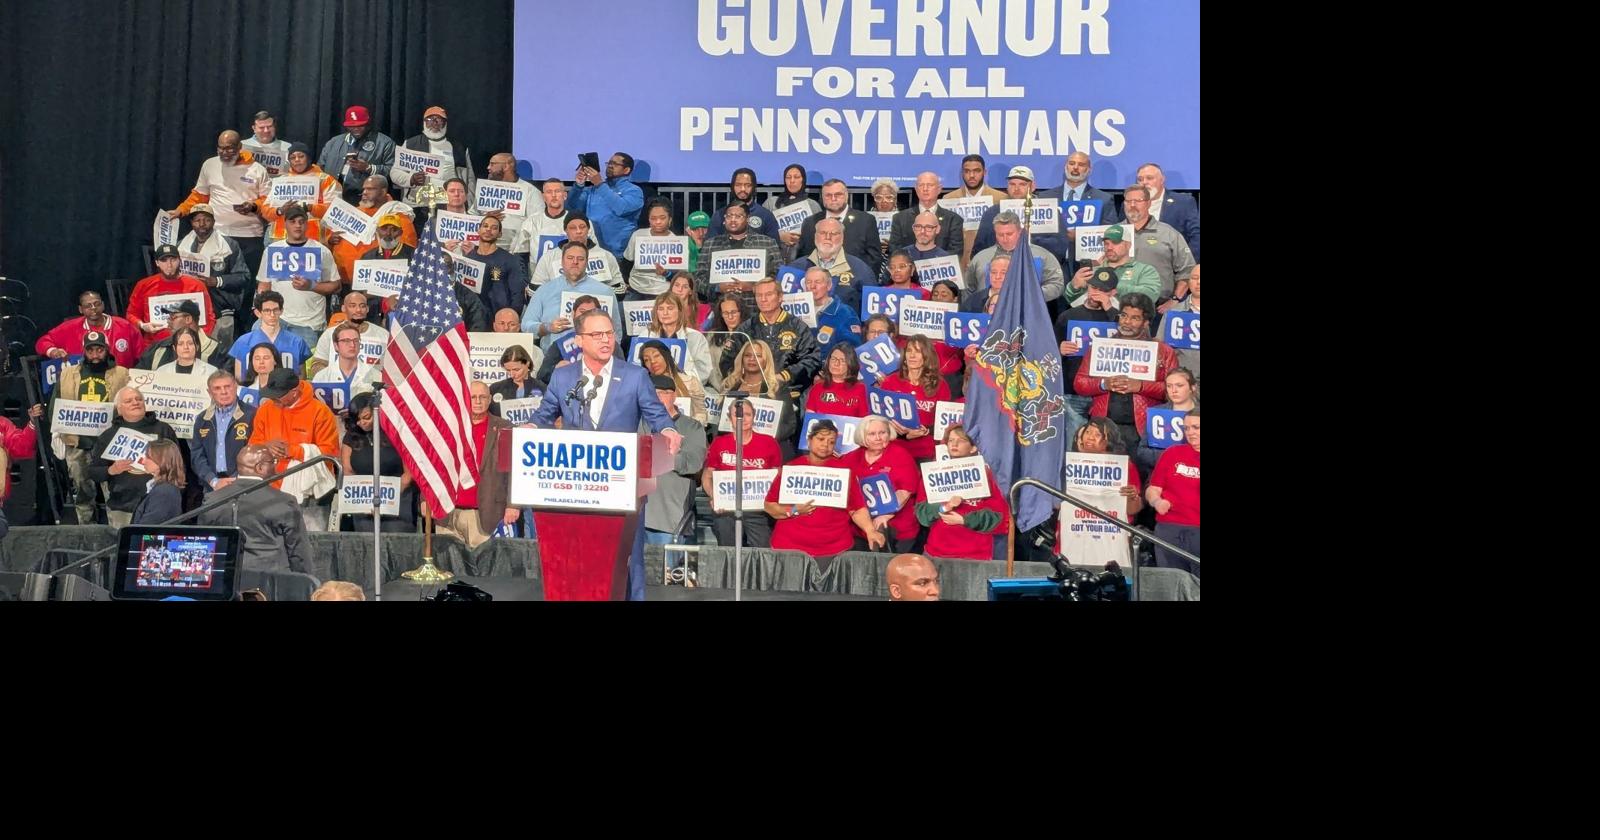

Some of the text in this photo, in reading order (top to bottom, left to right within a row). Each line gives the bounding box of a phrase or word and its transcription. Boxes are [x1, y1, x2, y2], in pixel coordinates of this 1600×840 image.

[697, 0, 1110, 57] GOVERNOR
[776, 67, 1024, 98] FOR ALL
[680, 106, 1126, 156] PENNSYLVANIANS
[399, 152, 440, 167] SHAPIRO
[399, 160, 424, 173] DAVIS
[273, 184, 315, 196] SHAPIRO
[479, 186, 523, 201] SHAPIRO
[478, 197, 504, 209] DAVIS
[330, 206, 367, 234] SHAPIRO
[779, 210, 809, 229] APIRO
[1062, 204, 1096, 224] SD
[439, 229, 465, 241] DAVIS
[639, 243, 684, 255] SHAPIRO
[179, 260, 206, 273] APIRO
[639, 254, 667, 266] DAVIS
[715, 258, 761, 271] SHAPIRO
[904, 309, 944, 324] SHAPIR
[949, 317, 985, 341] GS
[1170, 317, 1200, 343] GS
[859, 342, 895, 373] SD
[1097, 346, 1152, 363] SHAPIRO
[1096, 359, 1130, 374] DAVIS
[152, 384, 202, 395] Pennsylvania
[144, 396, 204, 410] HYSICIANS
[869, 392, 913, 420] GSD
[58, 409, 108, 424] SHAPIRO
[64, 421, 99, 429] GOVERNOR
[1152, 415, 1185, 442] GS
[521, 440, 626, 471] SHAPIRO
[538, 470, 609, 482] GOVERNOR
[928, 467, 981, 488] SHAPIRO
[1066, 463, 1122, 481] SHAPIRO
[553, 482, 573, 490] GSD
[575, 483, 583, 491] TO
[583, 484, 609, 492] 32210
[786, 475, 842, 493] SHAPIRO
[937, 482, 974, 493] GOVERNOR
[1074, 479, 1113, 488] GOVERNOR
[543, 497, 591, 505] PHILADELPHIA,
[793, 489, 833, 498] GOVERNOR
[862, 479, 892, 508] SD
[1070, 523, 1083, 533] GOT
[1085, 524, 1103, 534] YOUR
